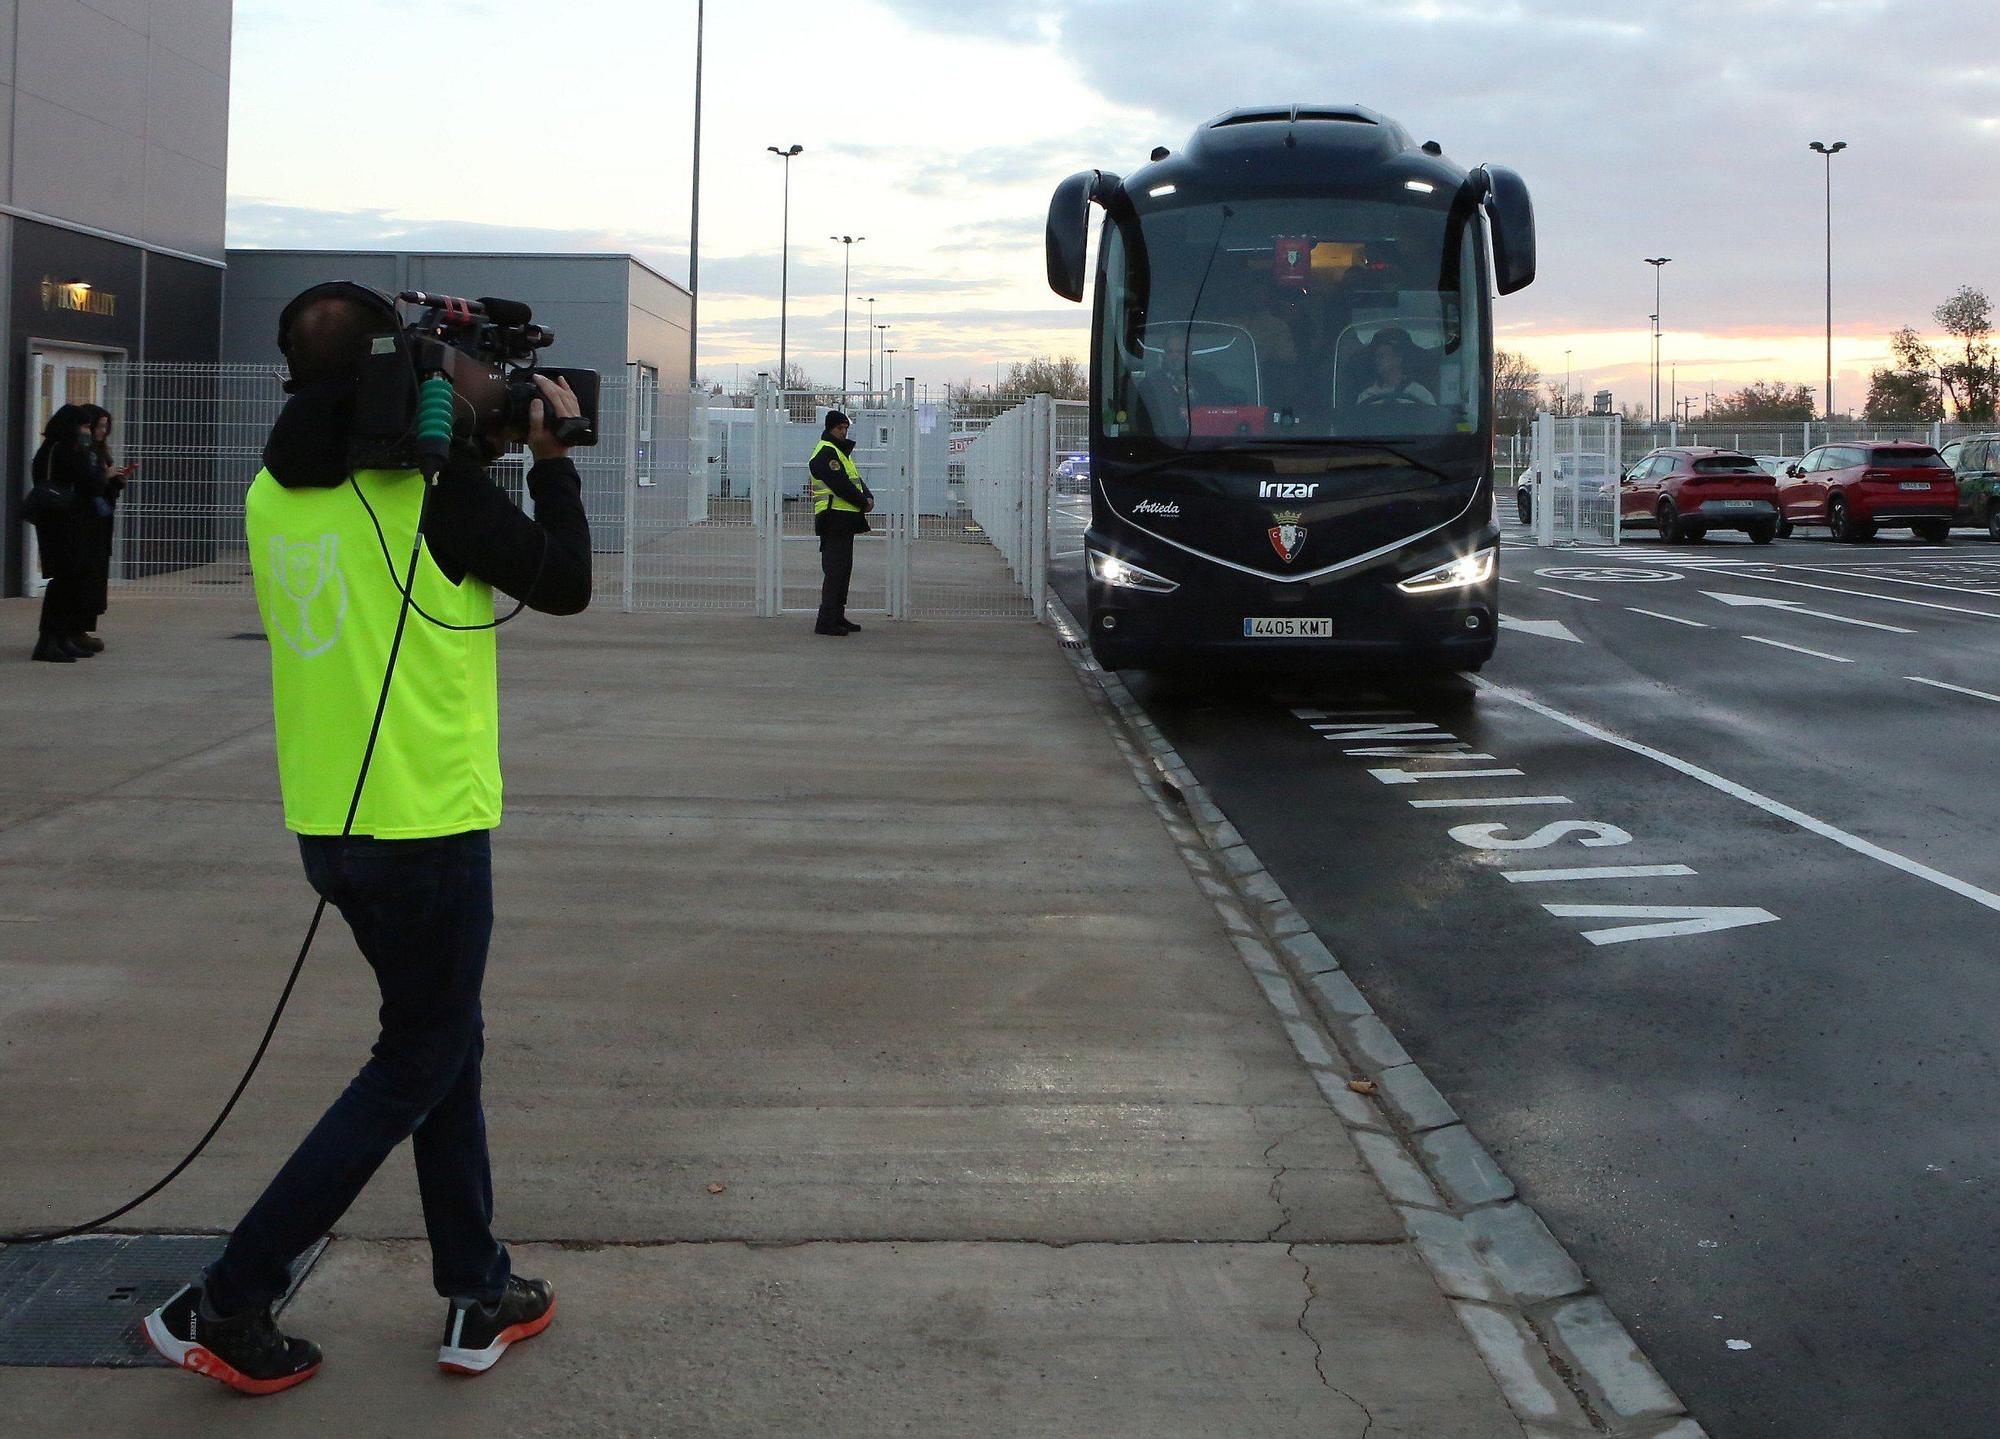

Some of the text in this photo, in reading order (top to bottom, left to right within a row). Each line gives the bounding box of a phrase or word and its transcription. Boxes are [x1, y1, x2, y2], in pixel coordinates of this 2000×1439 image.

[1259, 481, 1319, 498] Irizar
[1132, 499, 1180, 513] Artieda
[1255, 620, 1329, 635] 4405 KMT
